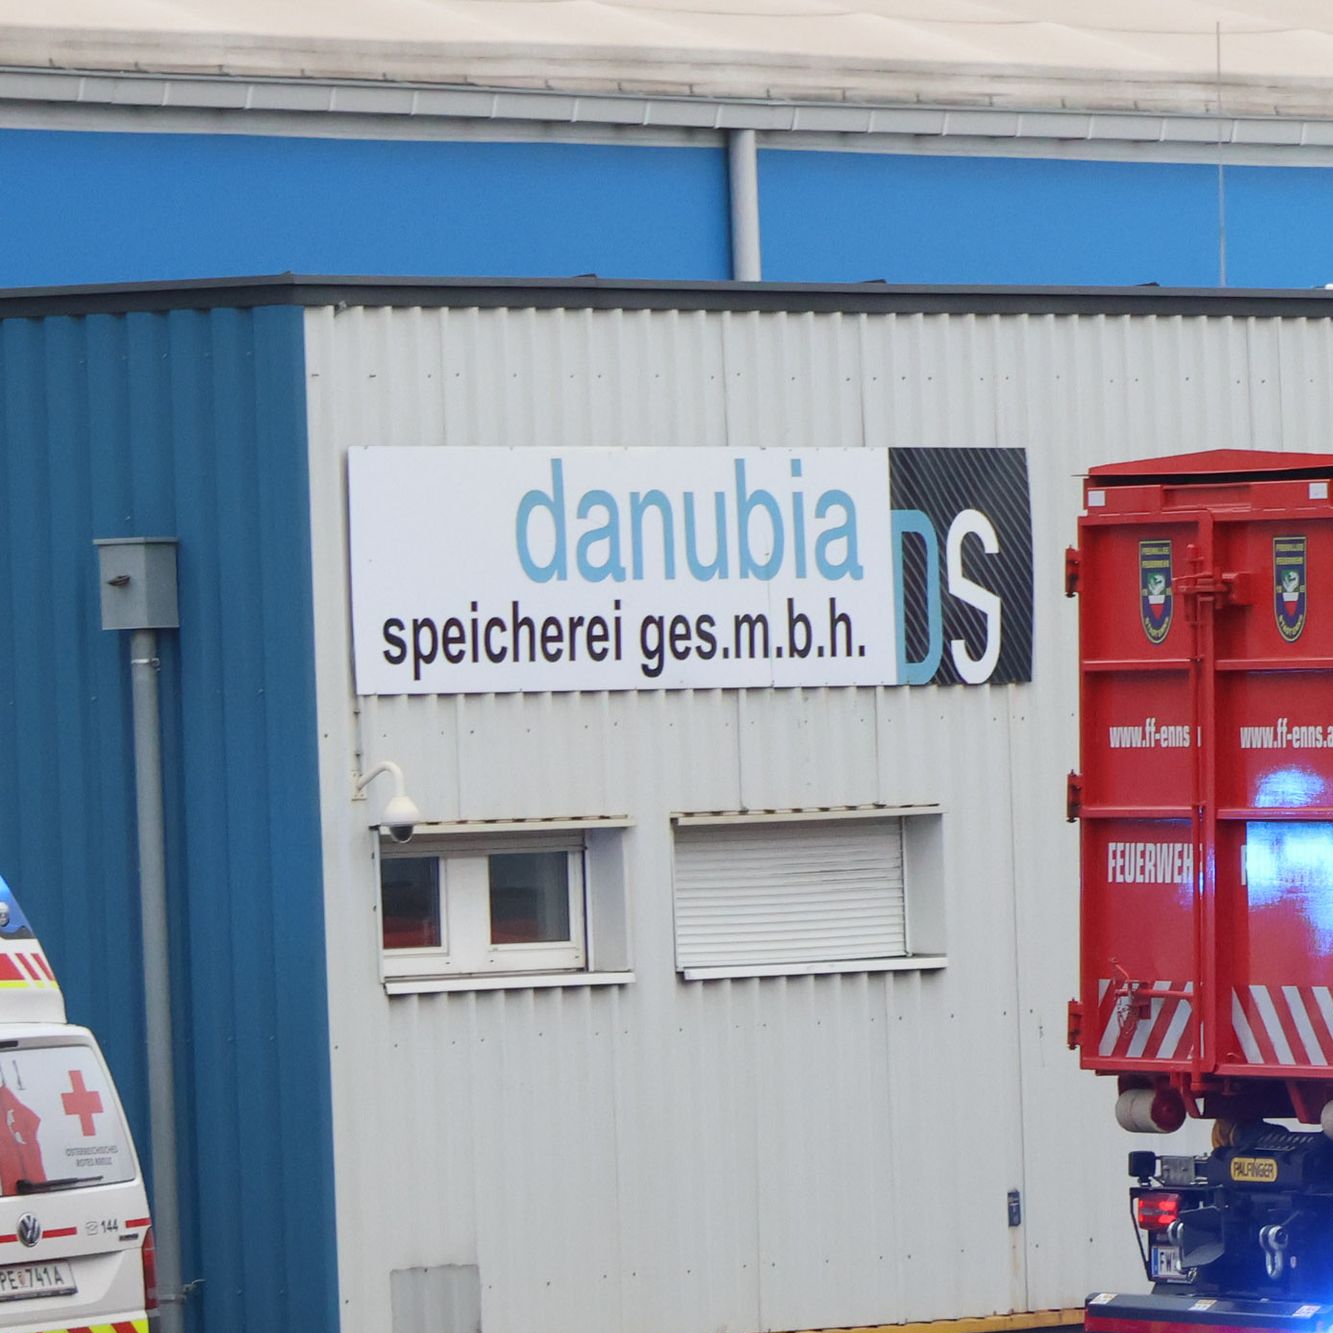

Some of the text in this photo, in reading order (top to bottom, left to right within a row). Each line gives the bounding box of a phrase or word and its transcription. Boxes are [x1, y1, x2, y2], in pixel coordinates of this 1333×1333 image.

[515, 458, 864, 584] danubia
[891, 509, 1001, 685] DS
[383, 598, 866, 680] speicherei ges.m.b.h.
[1108, 842, 1203, 883] FEUERWEH
[1234, 1161, 1274, 1178] PALFINGER
[101, 1218, 119, 1233] 144
